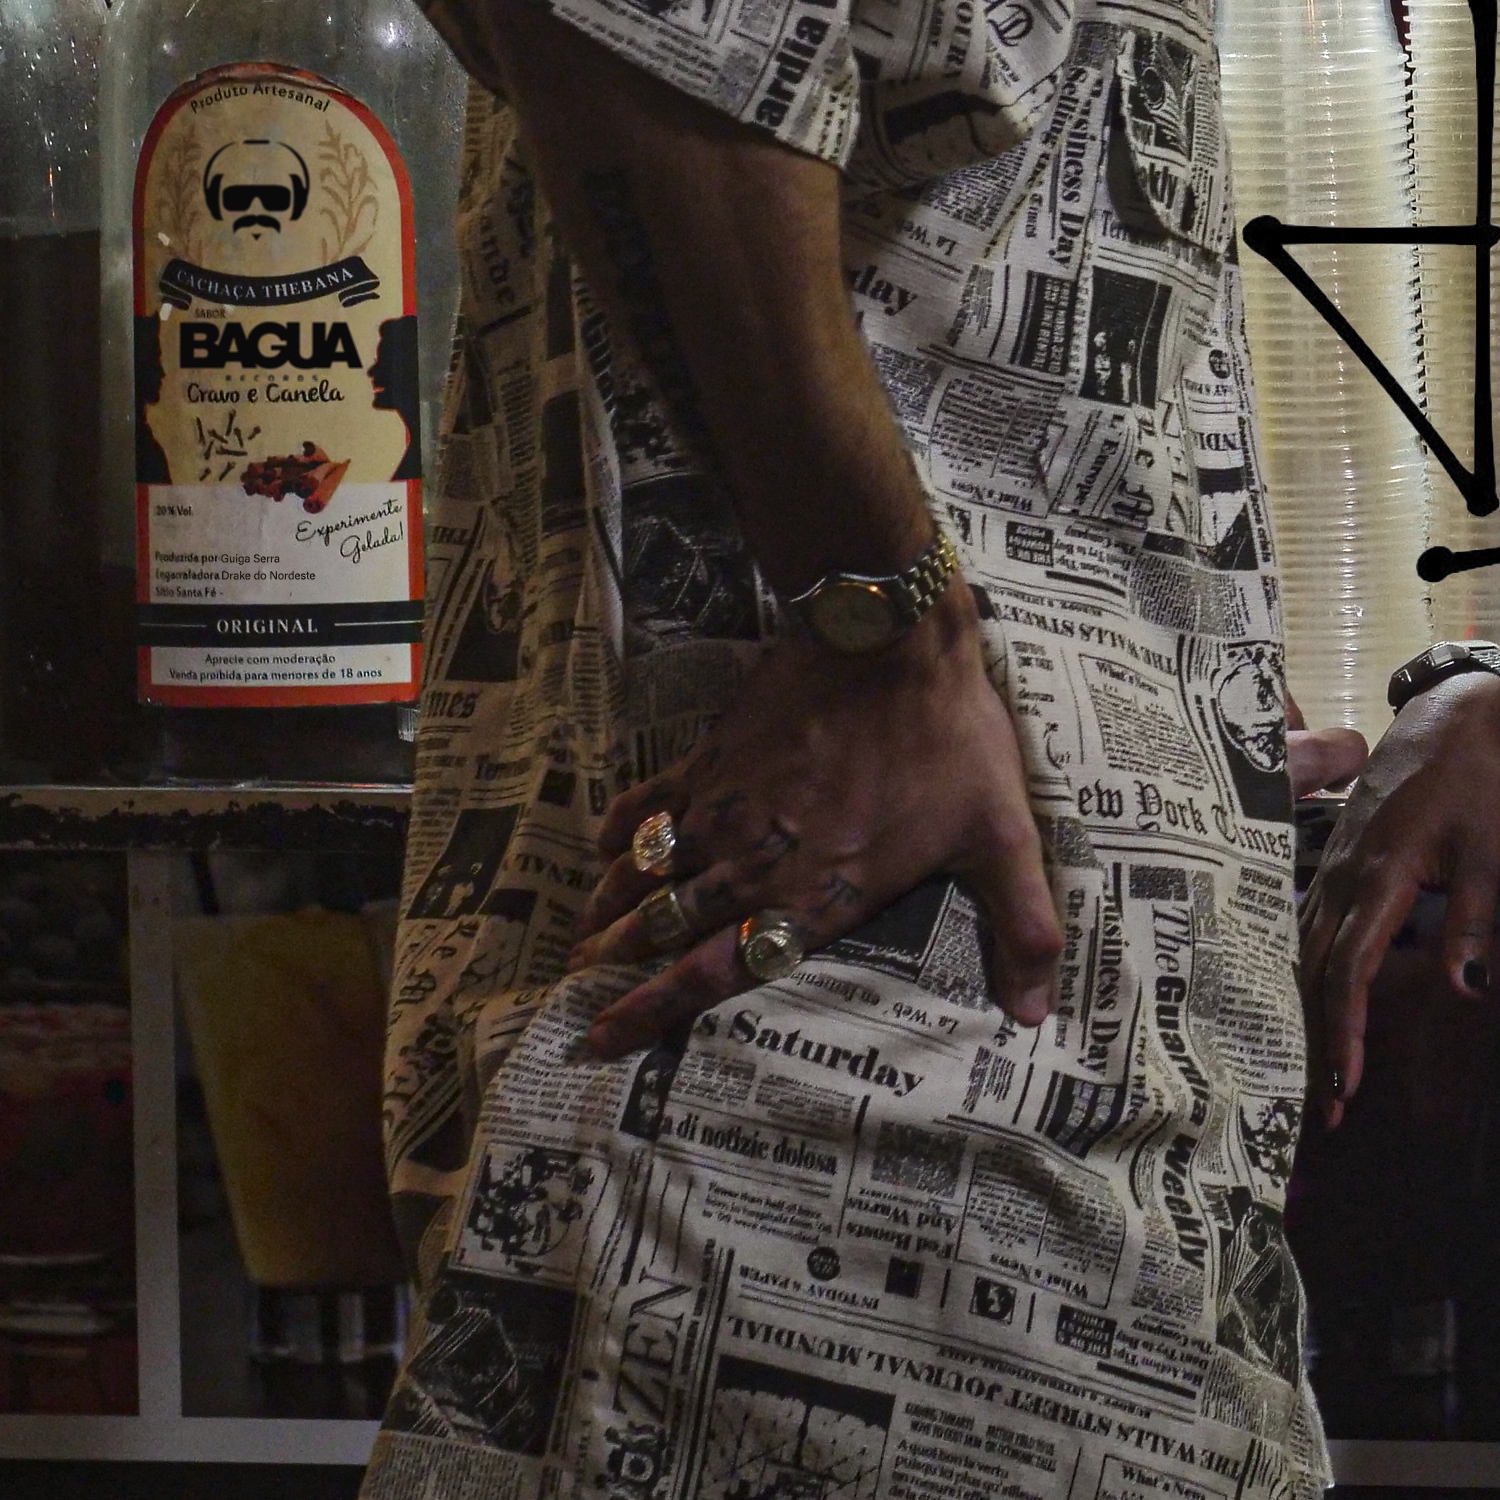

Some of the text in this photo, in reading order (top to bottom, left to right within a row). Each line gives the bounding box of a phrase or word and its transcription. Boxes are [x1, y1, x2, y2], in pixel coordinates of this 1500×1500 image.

[189, 82, 332, 114] Produto Artesanal
[176, 266, 354, 299] CACHAÇA THEBANA
[194, 308, 226, 319] SABOR
[179, 321, 362, 370] BAGUA
[187, 379, 345, 404] Cravo e Canela
[225, 374, 319, 382] RECORDS
[295, 499, 403, 547] Experimente
[340, 524, 405, 564] Gelada!
[155, 551, 280, 567] Produzida por Guiga Serra
[221, 570, 251, 581] Drake
[253, 570, 267, 581] do
[269, 570, 316, 581] Nordeste
[176, 586, 202, 598] Santa
[216, 618, 318, 635] ORIGINAL
[247, 655, 270, 664] com
[272, 652, 336, 666] moderação
[169, 668, 382, 683] Venda proibida para menores de 18 anos
[1077, 779, 1124, 820] ew
[1131, 779, 1209, 837] York
[728, 1007, 927, 1098] Saturday
[725, 1314, 862, 1368] MUNDIAL
[862, 1349, 1005, 1404] JOURNAL
